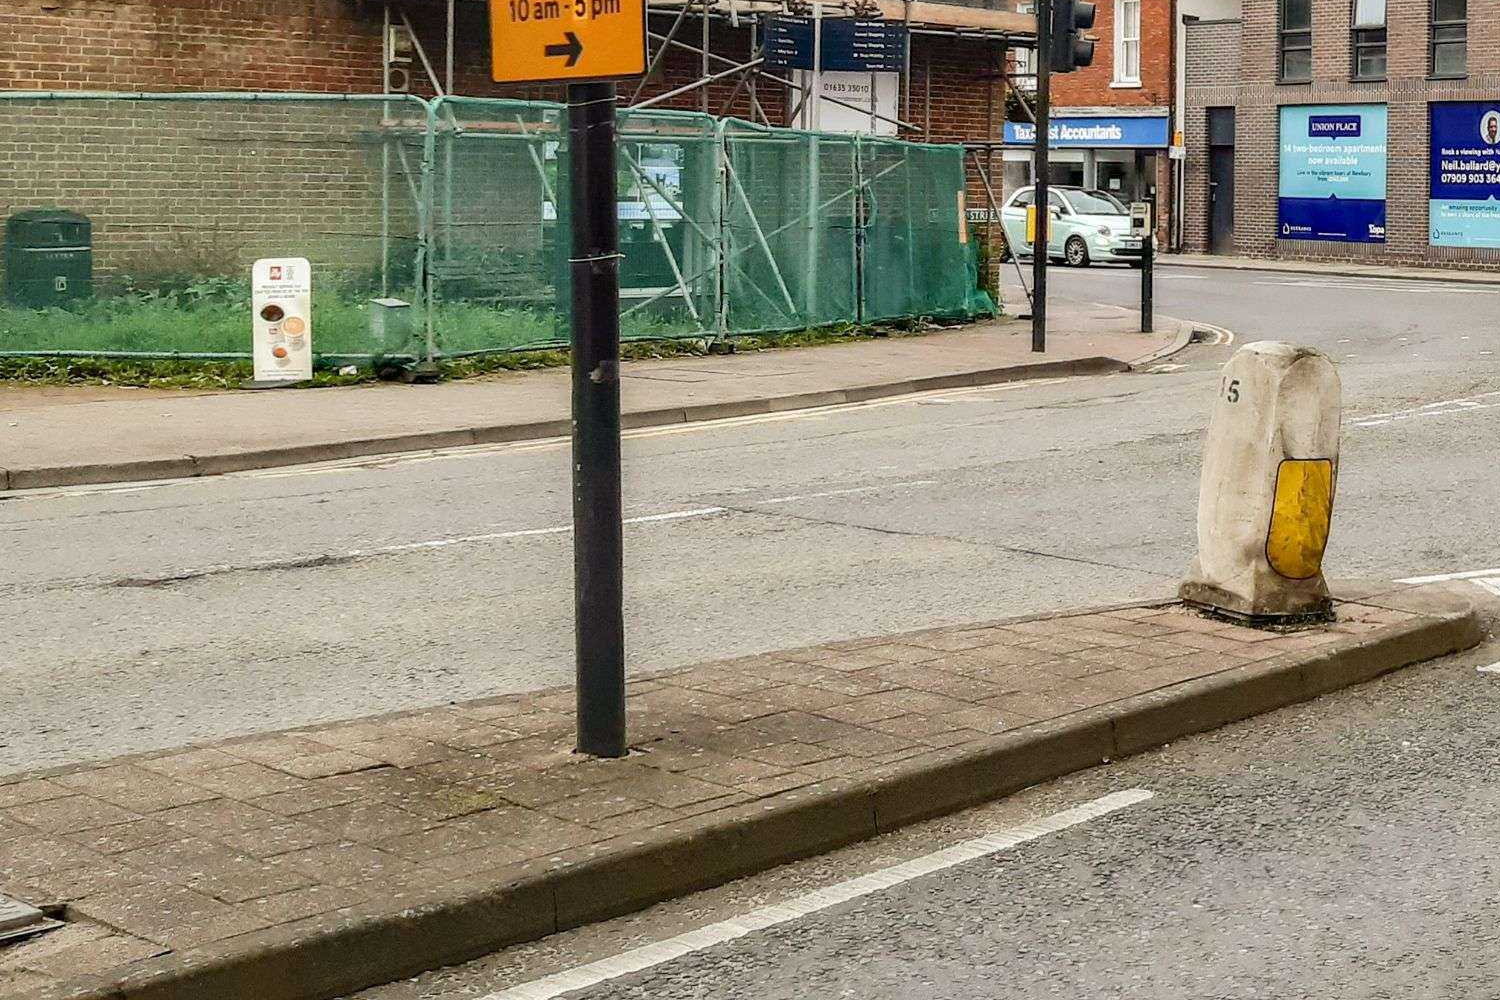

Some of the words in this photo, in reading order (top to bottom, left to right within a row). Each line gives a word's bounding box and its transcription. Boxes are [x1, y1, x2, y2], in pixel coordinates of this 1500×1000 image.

[534, 1, 560, 20] am
[1013, 124, 1059, 140] TaxAst
[1060, 124, 1122, 140] Accountants
[1311, 122, 1335, 132] UNION
[1336, 122, 1358, 132] PLACE
[1441, 173, 1467, 184] 07909
[1468, 173, 1485, 184] 903
